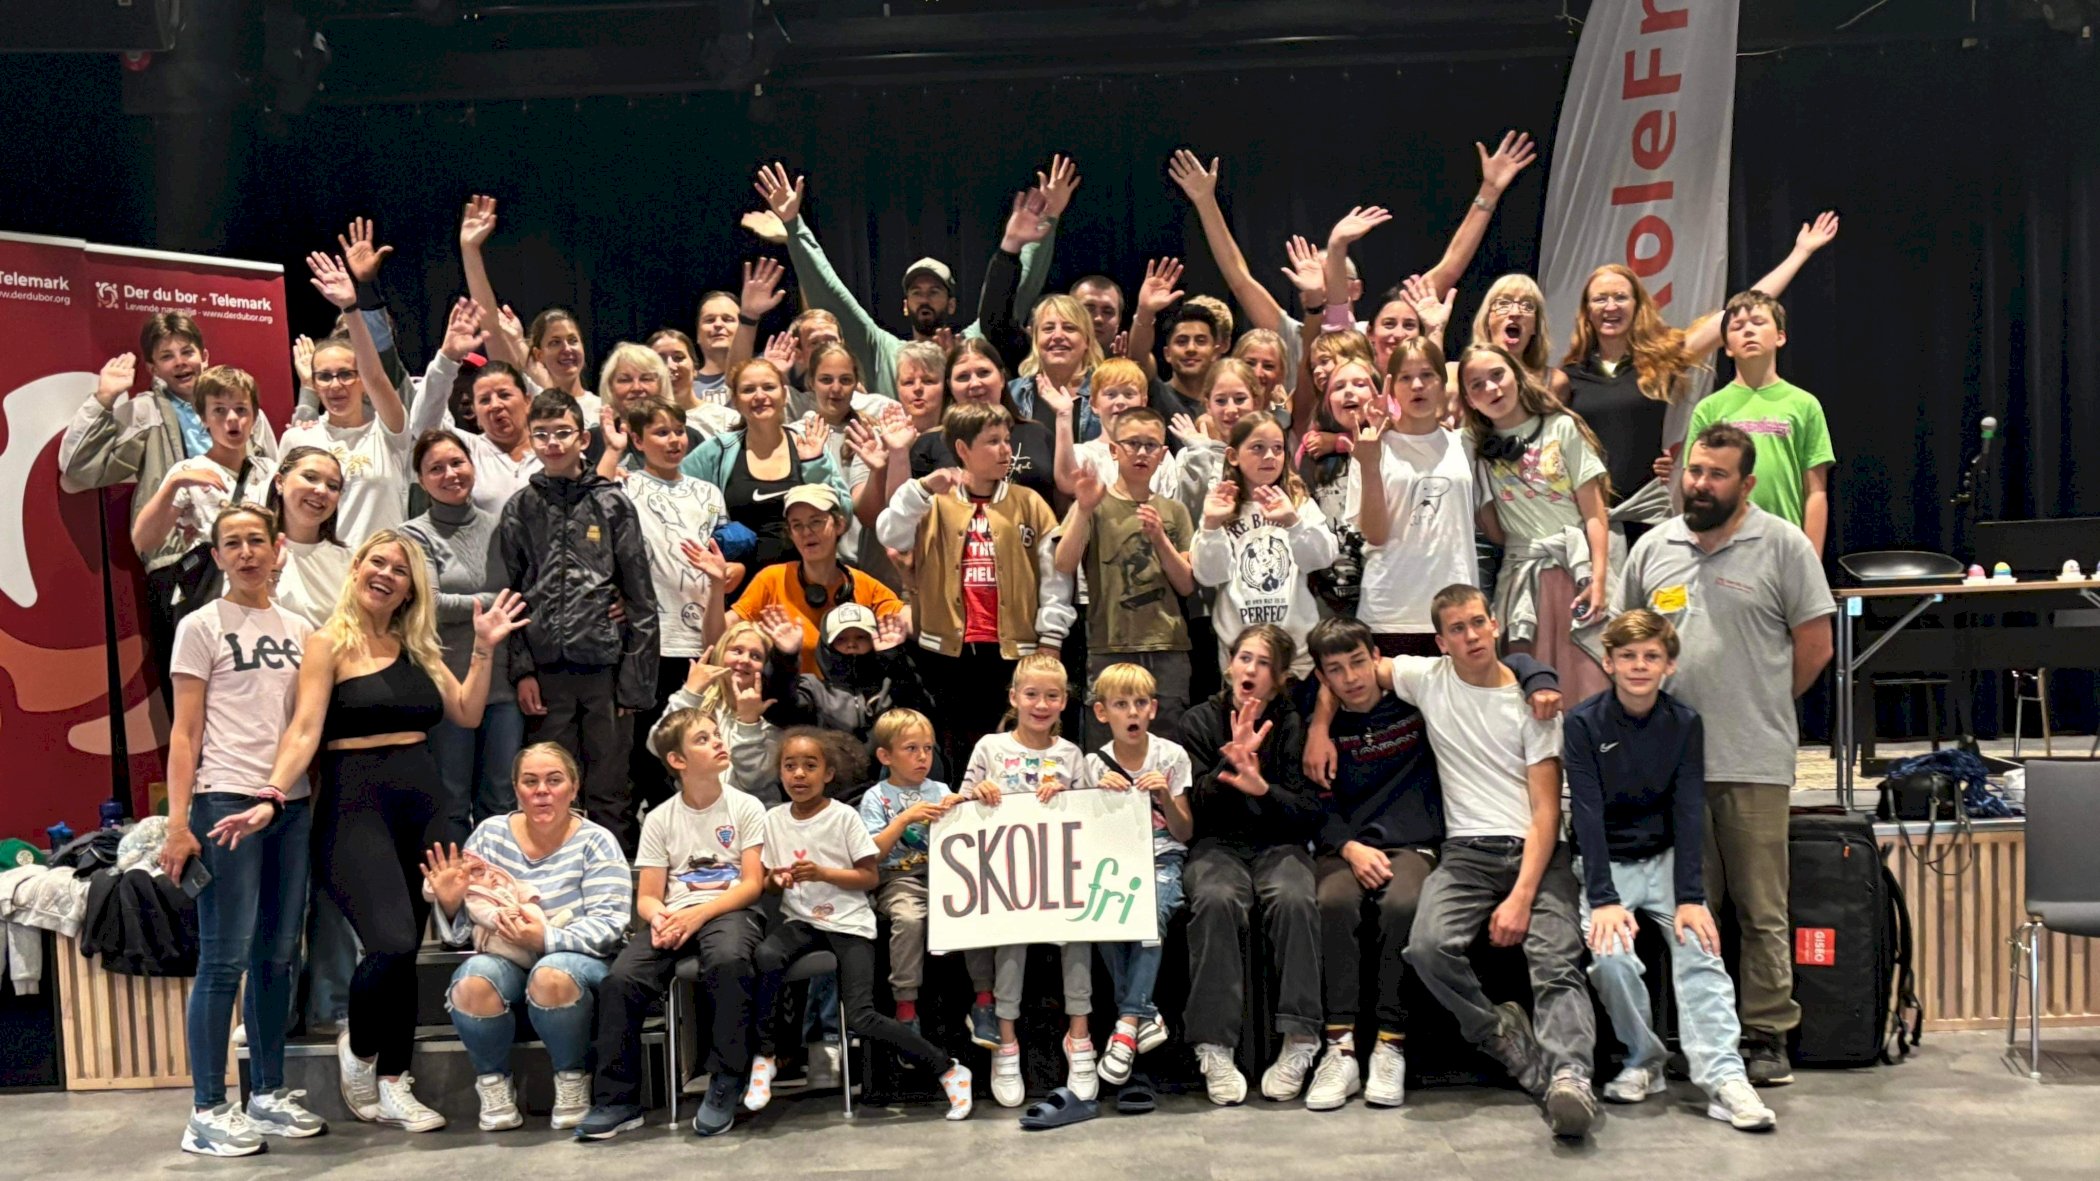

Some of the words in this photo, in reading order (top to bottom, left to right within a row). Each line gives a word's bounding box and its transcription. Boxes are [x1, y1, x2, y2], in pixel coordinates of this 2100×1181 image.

[123, 285, 149, 299] Der
[152, 287, 171, 301] du
[175, 289, 198, 304] bor
[209, 293, 272, 311] Telemark
[125, 302, 159, 313] Levende
[963, 566, 996, 582] FIEL
[225, 632, 304, 672] Lee
[940, 821, 1086, 918] SKOLE
[1065, 857, 1142, 925] fri
